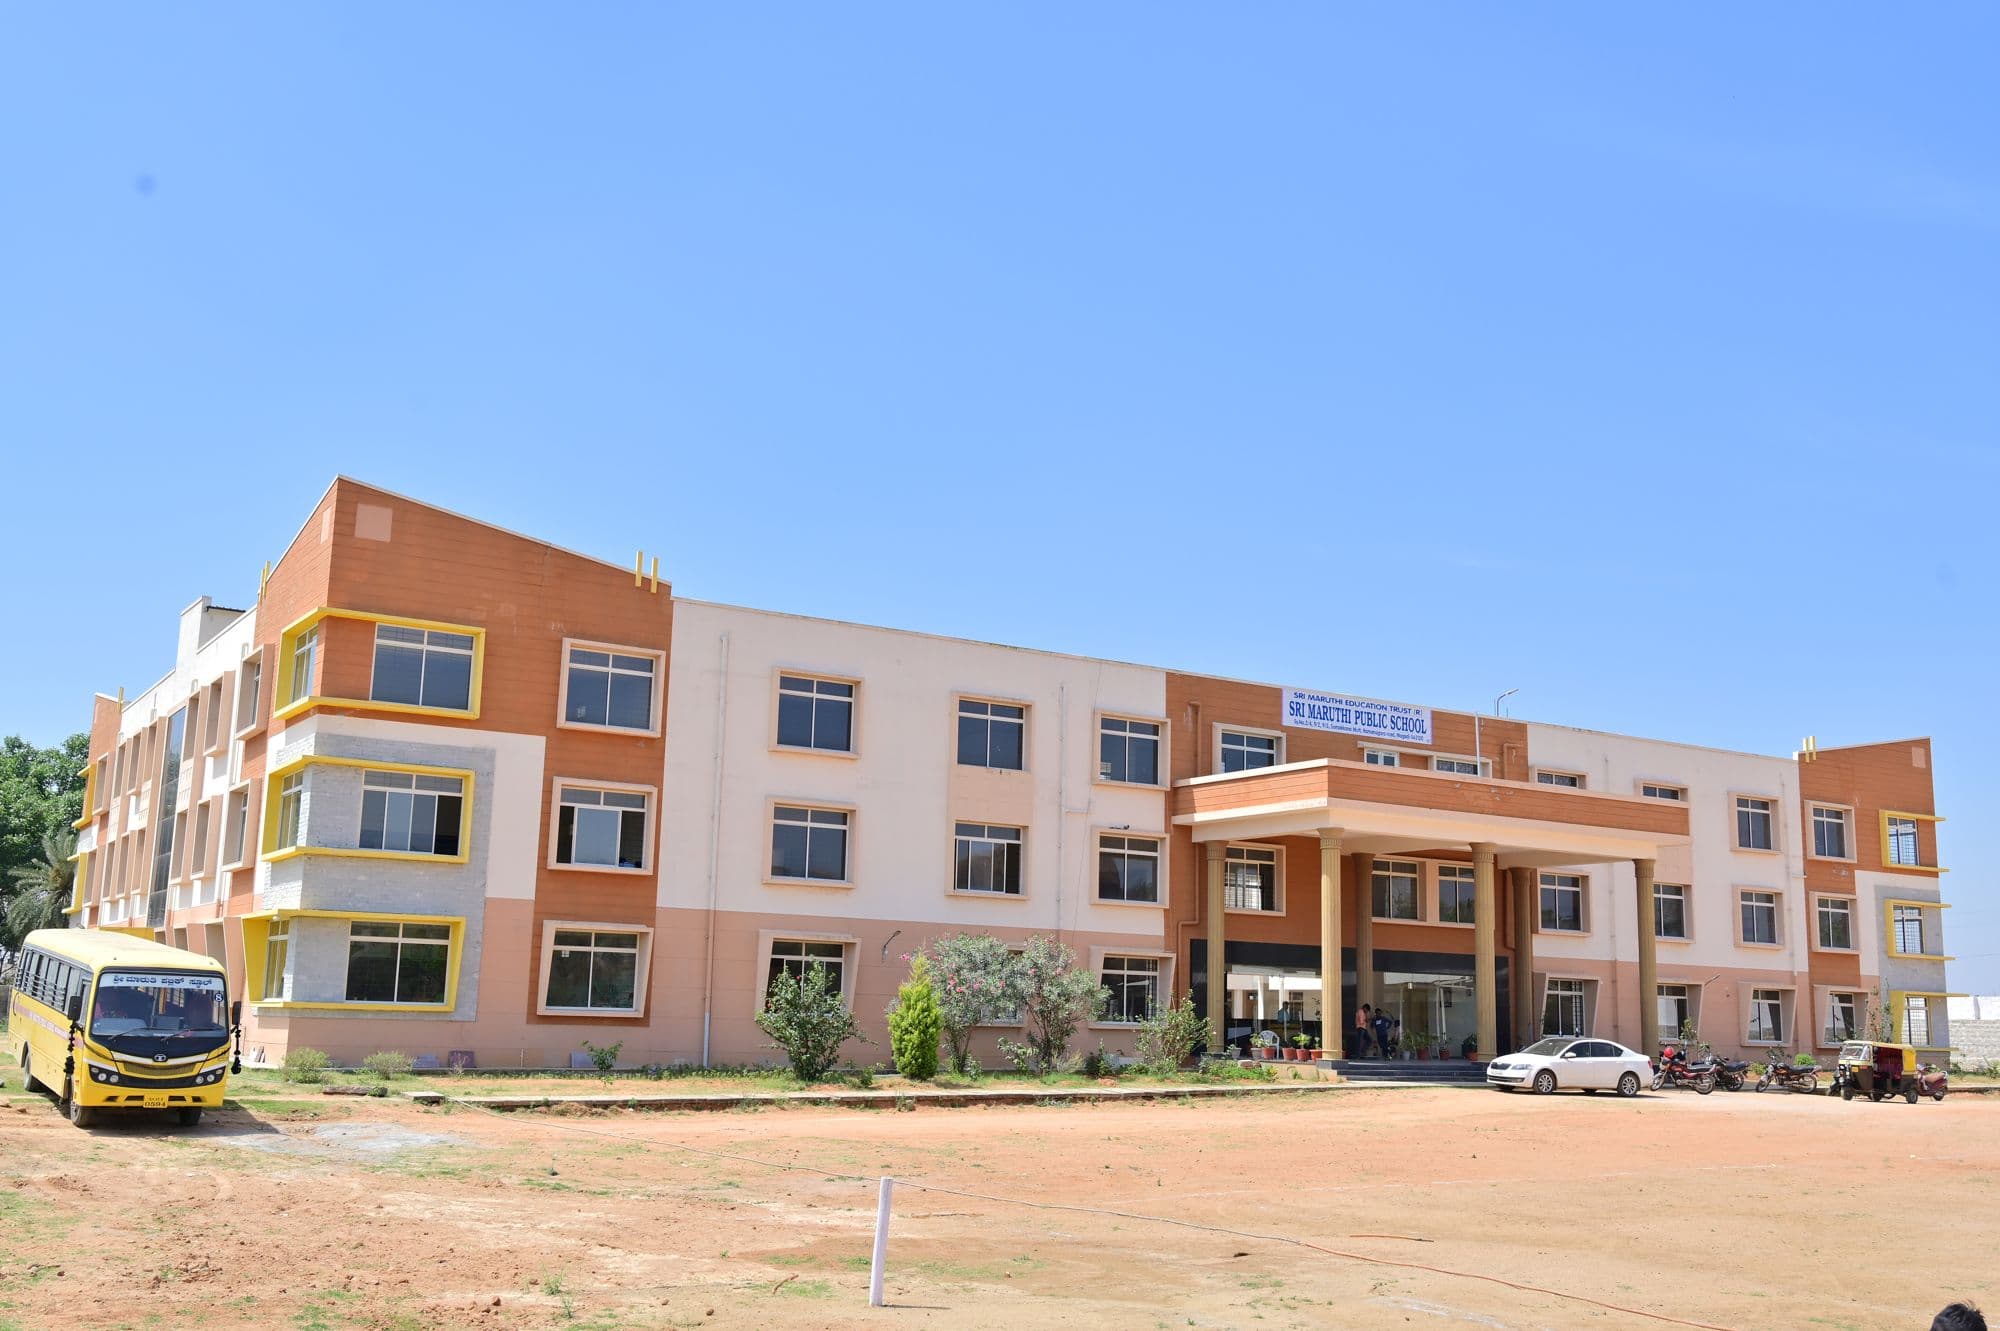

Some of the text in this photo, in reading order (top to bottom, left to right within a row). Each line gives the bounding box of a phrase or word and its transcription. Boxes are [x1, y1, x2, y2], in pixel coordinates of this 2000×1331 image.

[1293, 691, 1306, 700] SRI
[1308, 694, 1343, 705] MARUTHI
[1345, 699, 1388, 711] EDUCATION
[1389, 705, 1412, 715] TRUST
[1289, 700, 1305, 718] SRI
[1307, 703, 1351, 724] MARUTHI
[1354, 710, 1388, 729] PUBLIC
[1390, 715, 1427, 734] SCHOOL
[215, 993, 223, 1002] 8
